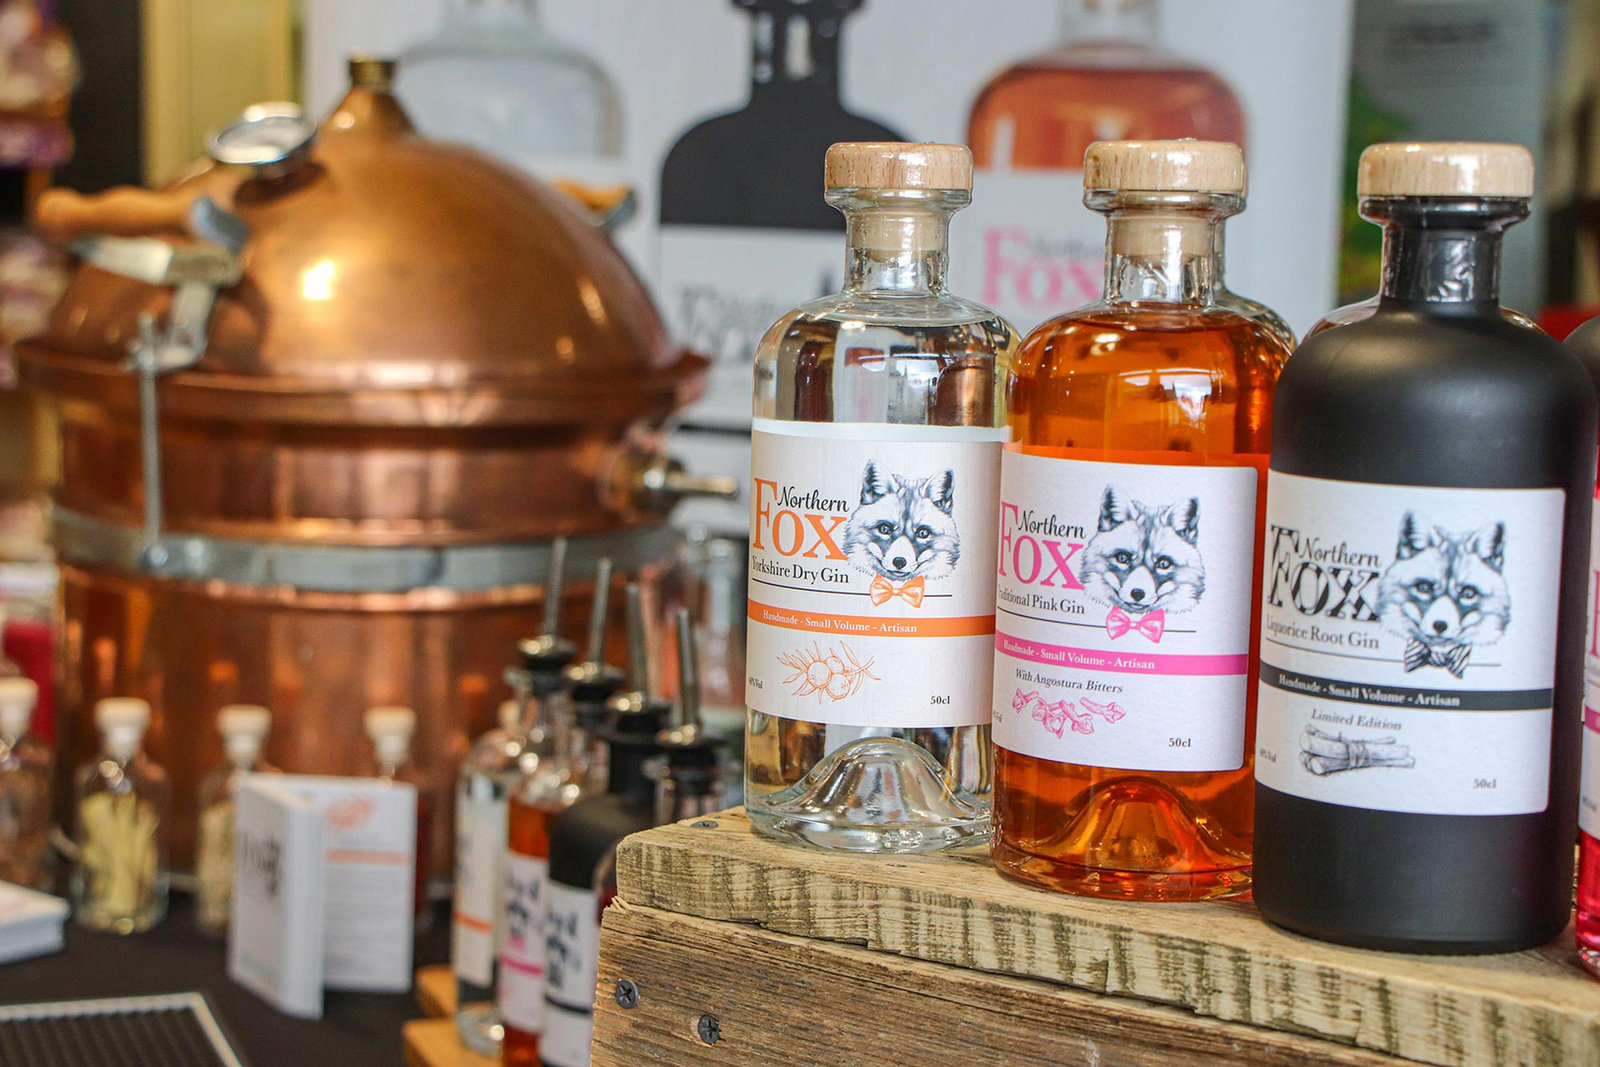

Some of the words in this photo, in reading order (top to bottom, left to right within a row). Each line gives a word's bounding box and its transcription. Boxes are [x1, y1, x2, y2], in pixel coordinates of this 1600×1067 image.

[777, 486, 850, 512] Northern
[1018, 510, 1087, 539] Northern
[1299, 537, 1382, 568] Northern
[752, 555, 790, 577] Yorkshire
[792, 563, 818, 585] Dry
[820, 567, 849, 583] Gin
[1032, 594, 1058, 612] Pink
[1060, 598, 1085, 615] Gin
[763, 609, 798, 625] Handmade
[805, 616, 831, 629] Small
[833, 619, 871, 632] Volume
[878, 623, 918, 633] Artisan
[1266, 613, 1308, 638] Liquorice
[1310, 625, 1345, 645] Root
[1347, 630, 1380, 650] Gin
[1003, 639, 1035, 656] Handmade
[1040, 648, 1066, 662] Small
[1067, 652, 1105, 666] Volume
[1113, 657, 1155, 670] Artisan
[1015, 667, 1033, 682] With
[1034, 673, 1083, 691] Angostura
[1086, 680, 1124, 694] Bitters
[1278, 673, 1322, 693] Handmade
[1328, 683, 1360, 699] Small
[1360, 687, 1406, 704] Volume
[1414, 692, 1461, 707] Artisan
[930, 695, 951, 705] 50cl
[1311, 708, 1354, 726] Limited
[1356, 714, 1403, 731] Edition
[1168, 737, 1192, 748] 50cl
[1473, 778, 1497, 790] 50cl
